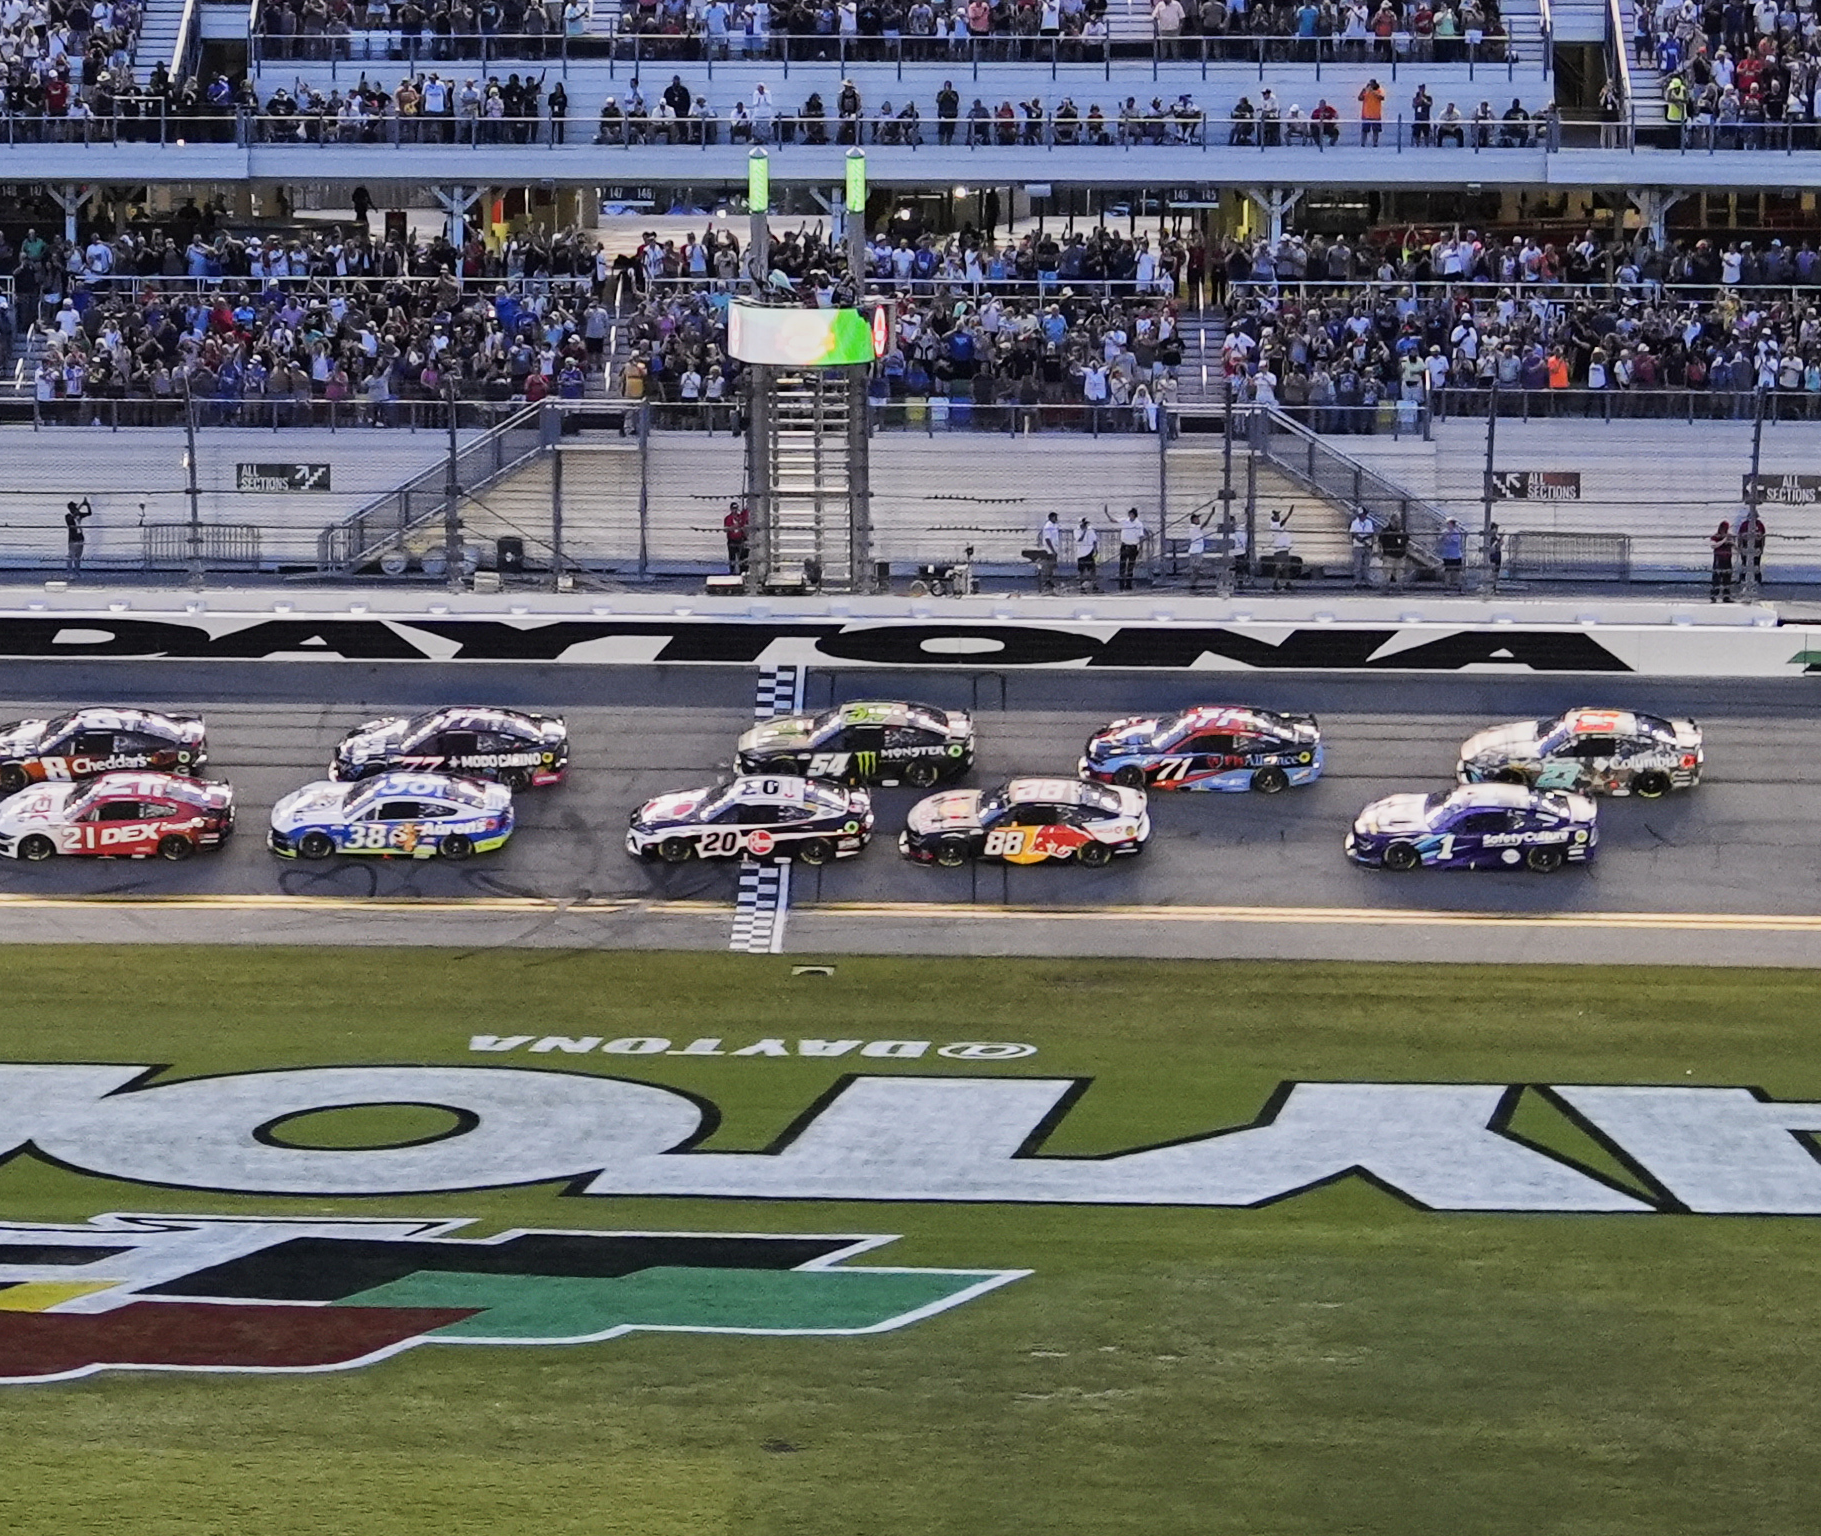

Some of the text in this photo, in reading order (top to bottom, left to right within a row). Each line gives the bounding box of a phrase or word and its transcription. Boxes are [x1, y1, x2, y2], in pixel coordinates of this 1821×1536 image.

[609, 187, 623, 199] 147
[1202, 189, 1217, 200] 145
[241, 464, 259, 476] ALL
[1527, 472, 1545, 485] ALL
[241, 477, 289, 490] SECTIONS
[1782, 474, 1799, 487] ALL
[1527, 485, 1577, 498] SECTIONS
[1766, 489, 1816, 502] SECTIONS
[498, 752, 542, 768] CAINO
[881, 745, 948, 759] MONSTER
[1246, 753, 1300, 767] Allnce
[40, 756, 73, 782] 8
[72, 753, 148, 773] Cheddar's
[400, 755, 446, 772] 77
[806, 752, 851, 777] 54
[1155, 757, 1195, 781] 71
[1608, 753, 1680, 772] Columbia
[100, 823, 162, 846] DEX
[347, 824, 387, 848] 38
[423, 820, 486, 836] Aaron's
[60, 826, 96, 850] 21
[702, 830, 739, 852] 20
[984, 830, 1025, 856] 88
[1436, 832, 1456, 861] 1
[1483, 830, 1569, 848] SafetyCulture
[468, 1034, 1038, 1060] @DAYTONA
